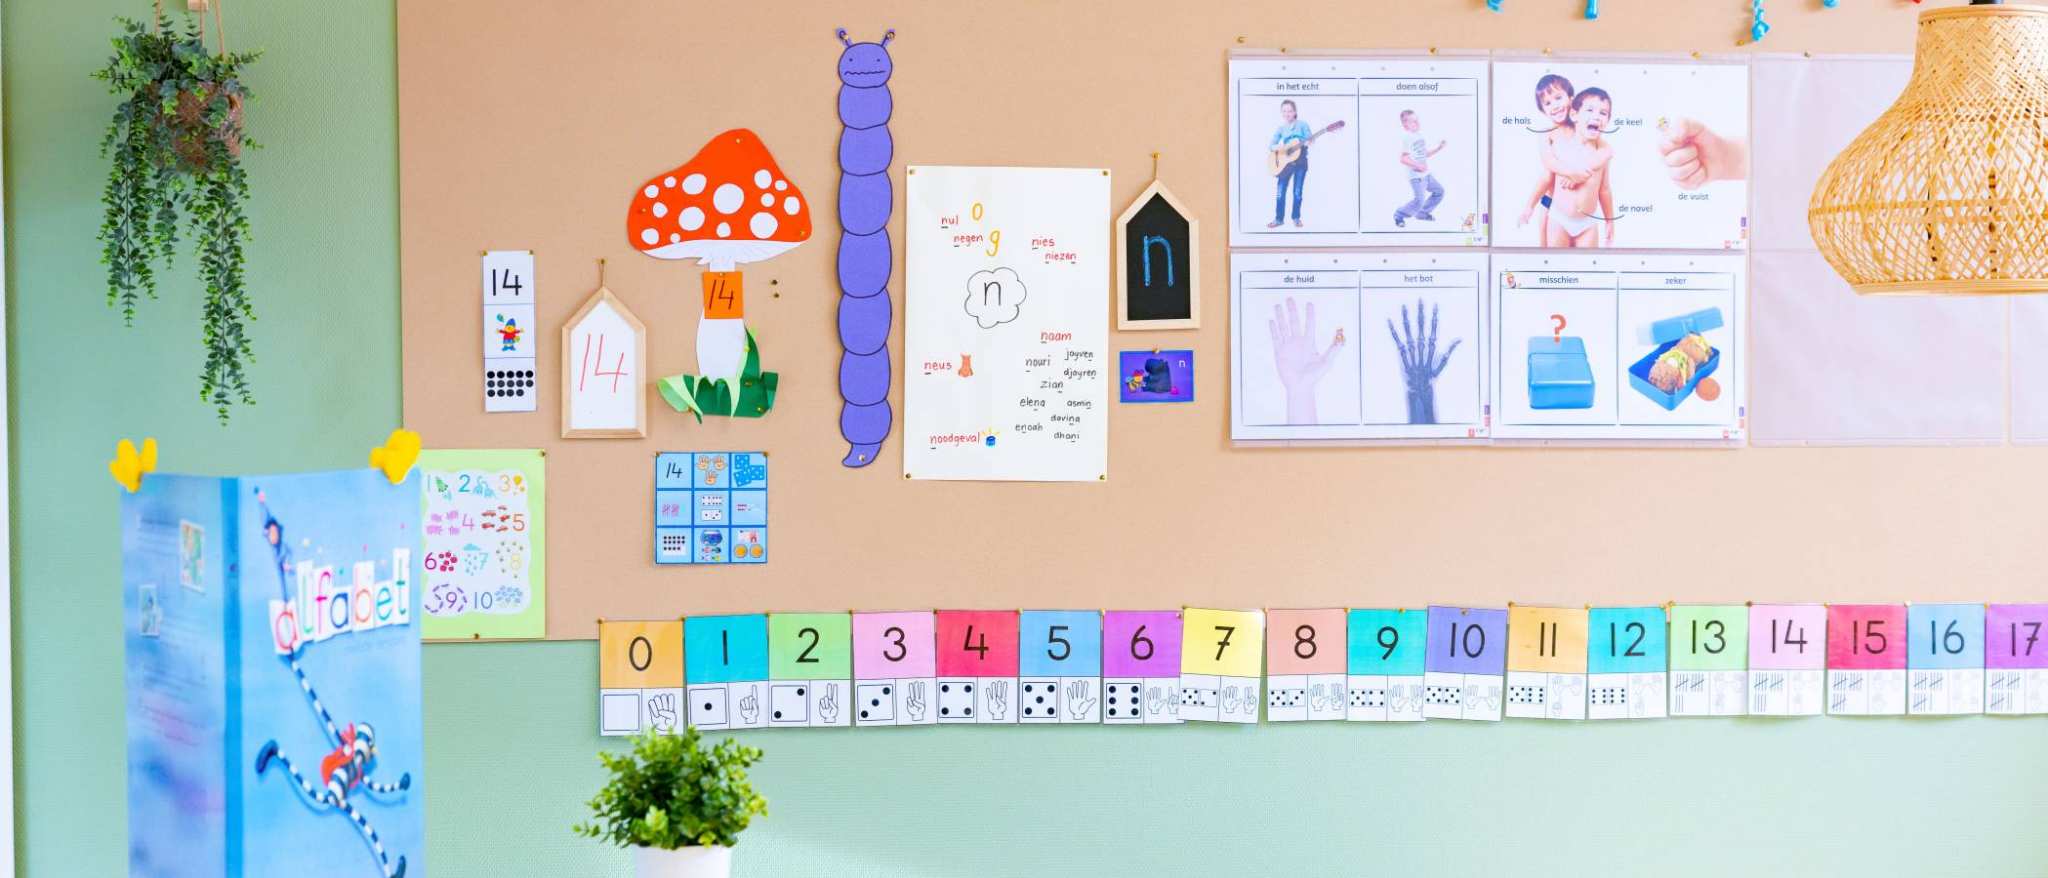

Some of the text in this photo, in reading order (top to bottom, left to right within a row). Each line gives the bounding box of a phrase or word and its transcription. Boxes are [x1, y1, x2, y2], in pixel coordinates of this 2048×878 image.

[1276, 82, 1319, 91] in het echt
[1396, 82, 1439, 93] doen alsof
[1502, 116, 1531, 125] de hals
[1614, 118, 1643, 126] de keel
[1619, 204, 1653, 213] de navel
[1678, 192, 1709, 201] de vuist
[941, 215, 960, 226] nul
[953, 233, 984, 247] negen
[1032, 235, 1055, 247] nies
[1143, 234, 1174, 287] n
[492, 268, 523, 297] 14
[1284, 275, 1315, 284] de huid
[1404, 274, 1433, 283] het bot
[1539, 276, 1579, 285] misschien
[1665, 276, 1687, 285] zeker
[708, 279, 736, 311] 14
[984, 281, 1001, 306] n
[1041, 331, 1072, 342] naam
[579, 333, 628, 393] 14
[924, 360, 952, 371] neus
[1179, 360, 1186, 368] n
[1019, 396, 1046, 407] elena
[929, 432, 980, 446] noodgeval
[666, 462, 683, 479] 14
[458, 474, 471, 493] 2
[499, 475, 511, 492] 3
[462, 513, 525, 532] 4 5
[425, 552, 437, 570] 6
[275, 550, 409, 652] alfabet
[446, 591, 493, 610] 9 10
[722, 629, 729, 666] 1
[795, 627, 820, 663] 2
[883, 626, 907, 662] 3
[963, 625, 989, 661] 4
[1047, 625, 1071, 661] 5
[1130, 624, 1154, 661] 6
[1214, 625, 1236, 661] 7
[1294, 624, 1318, 659] 8
[1377, 625, 1399, 660] 9
[1449, 622, 1486, 658] 10
[1539, 622, 1558, 658] 11
[1610, 622, 1646, 658] 12
[1691, 619, 1727, 655] 13
[1772, 619, 1808, 654] 14
[1852, 620, 1888, 655] 15
[1931, 619, 1966, 656] 16
[2010, 622, 2043, 657] 17
[629, 636, 653, 671] 0
